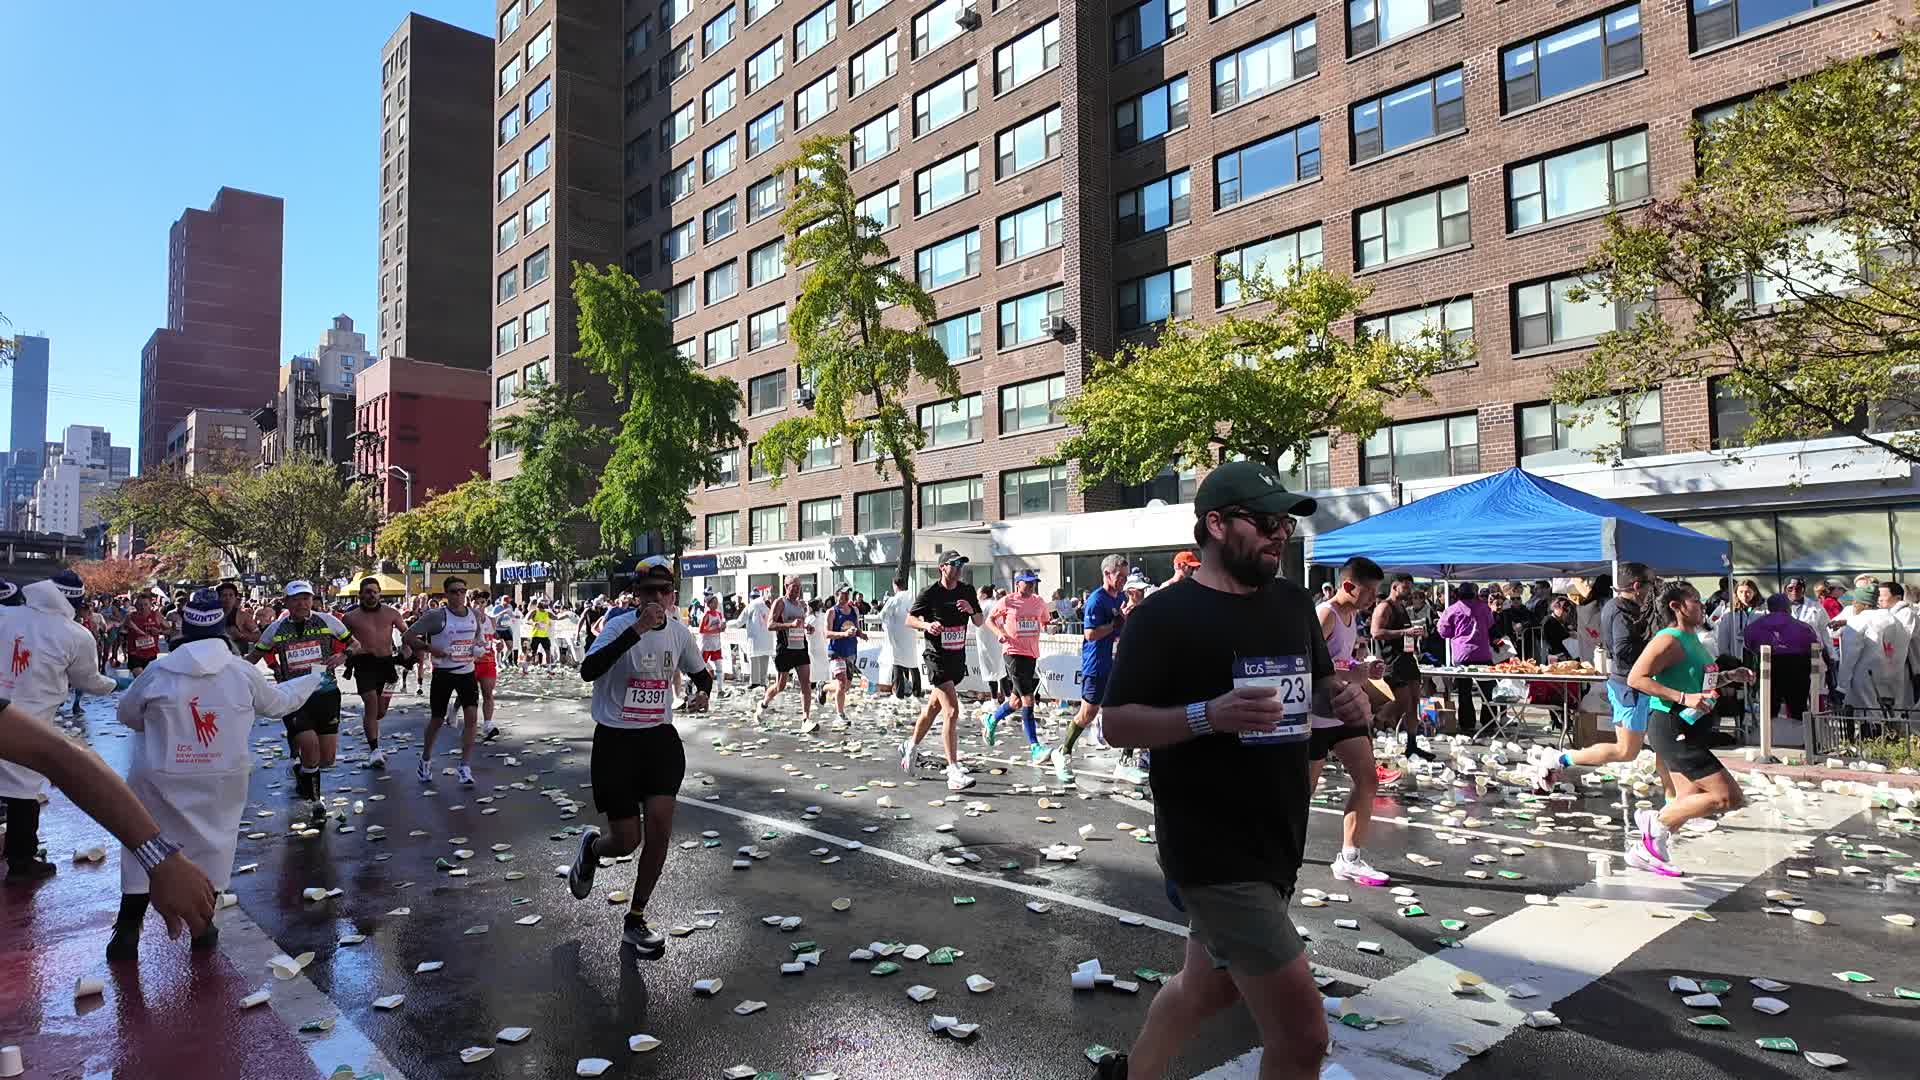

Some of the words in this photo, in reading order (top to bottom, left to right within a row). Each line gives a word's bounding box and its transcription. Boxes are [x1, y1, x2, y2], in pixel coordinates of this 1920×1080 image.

[784, 551, 815, 561] SATORI
[1244, 662, 1265, 675] tcs
[631, 689, 665, 704] 13391
